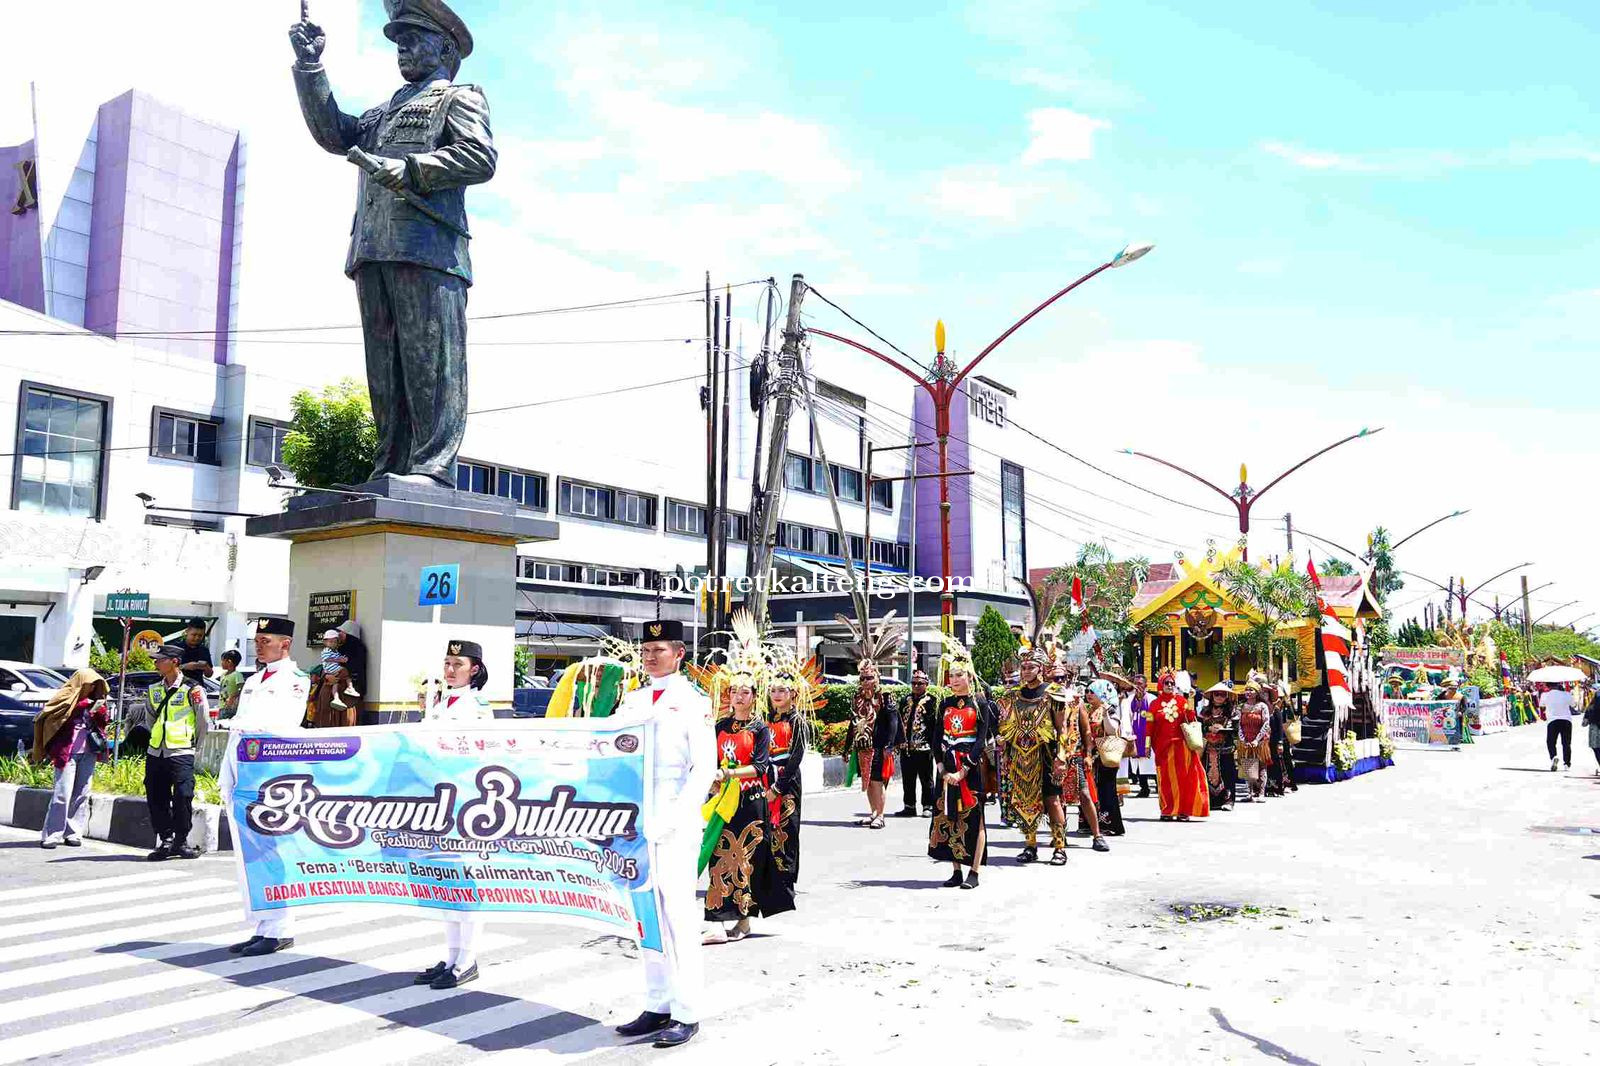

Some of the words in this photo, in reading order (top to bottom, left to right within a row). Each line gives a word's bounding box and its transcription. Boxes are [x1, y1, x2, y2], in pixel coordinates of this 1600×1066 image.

[426, 571, 451, 599] 26
[130, 599, 148, 611] RIWUT
[262, 749, 314, 757] KALIMANTAN
[316, 748, 346, 756] TENGAH
[263, 742, 313, 750] PEMERINTAH
[248, 777, 452, 847] Karnaval
[460, 768, 636, 842] Budaya
[372, 830, 433, 850] Festival
[433, 836, 499, 859] Budaya
[604, 848, 637, 880] 2025
[297, 861, 337, 875] Tema
[409, 861, 459, 881] Bangun
[463, 865, 555, 883] Kalimantan
[265, 883, 307, 901] BADAN
[309, 880, 366, 897] KESATUAN
[367, 881, 409, 897] BANGSA
[410, 883, 433, 900] DAN
[431, 886, 477, 903] POLITIK
[478, 888, 538, 904] PROVINSI
[540, 889, 614, 916] KALIMANTAN
